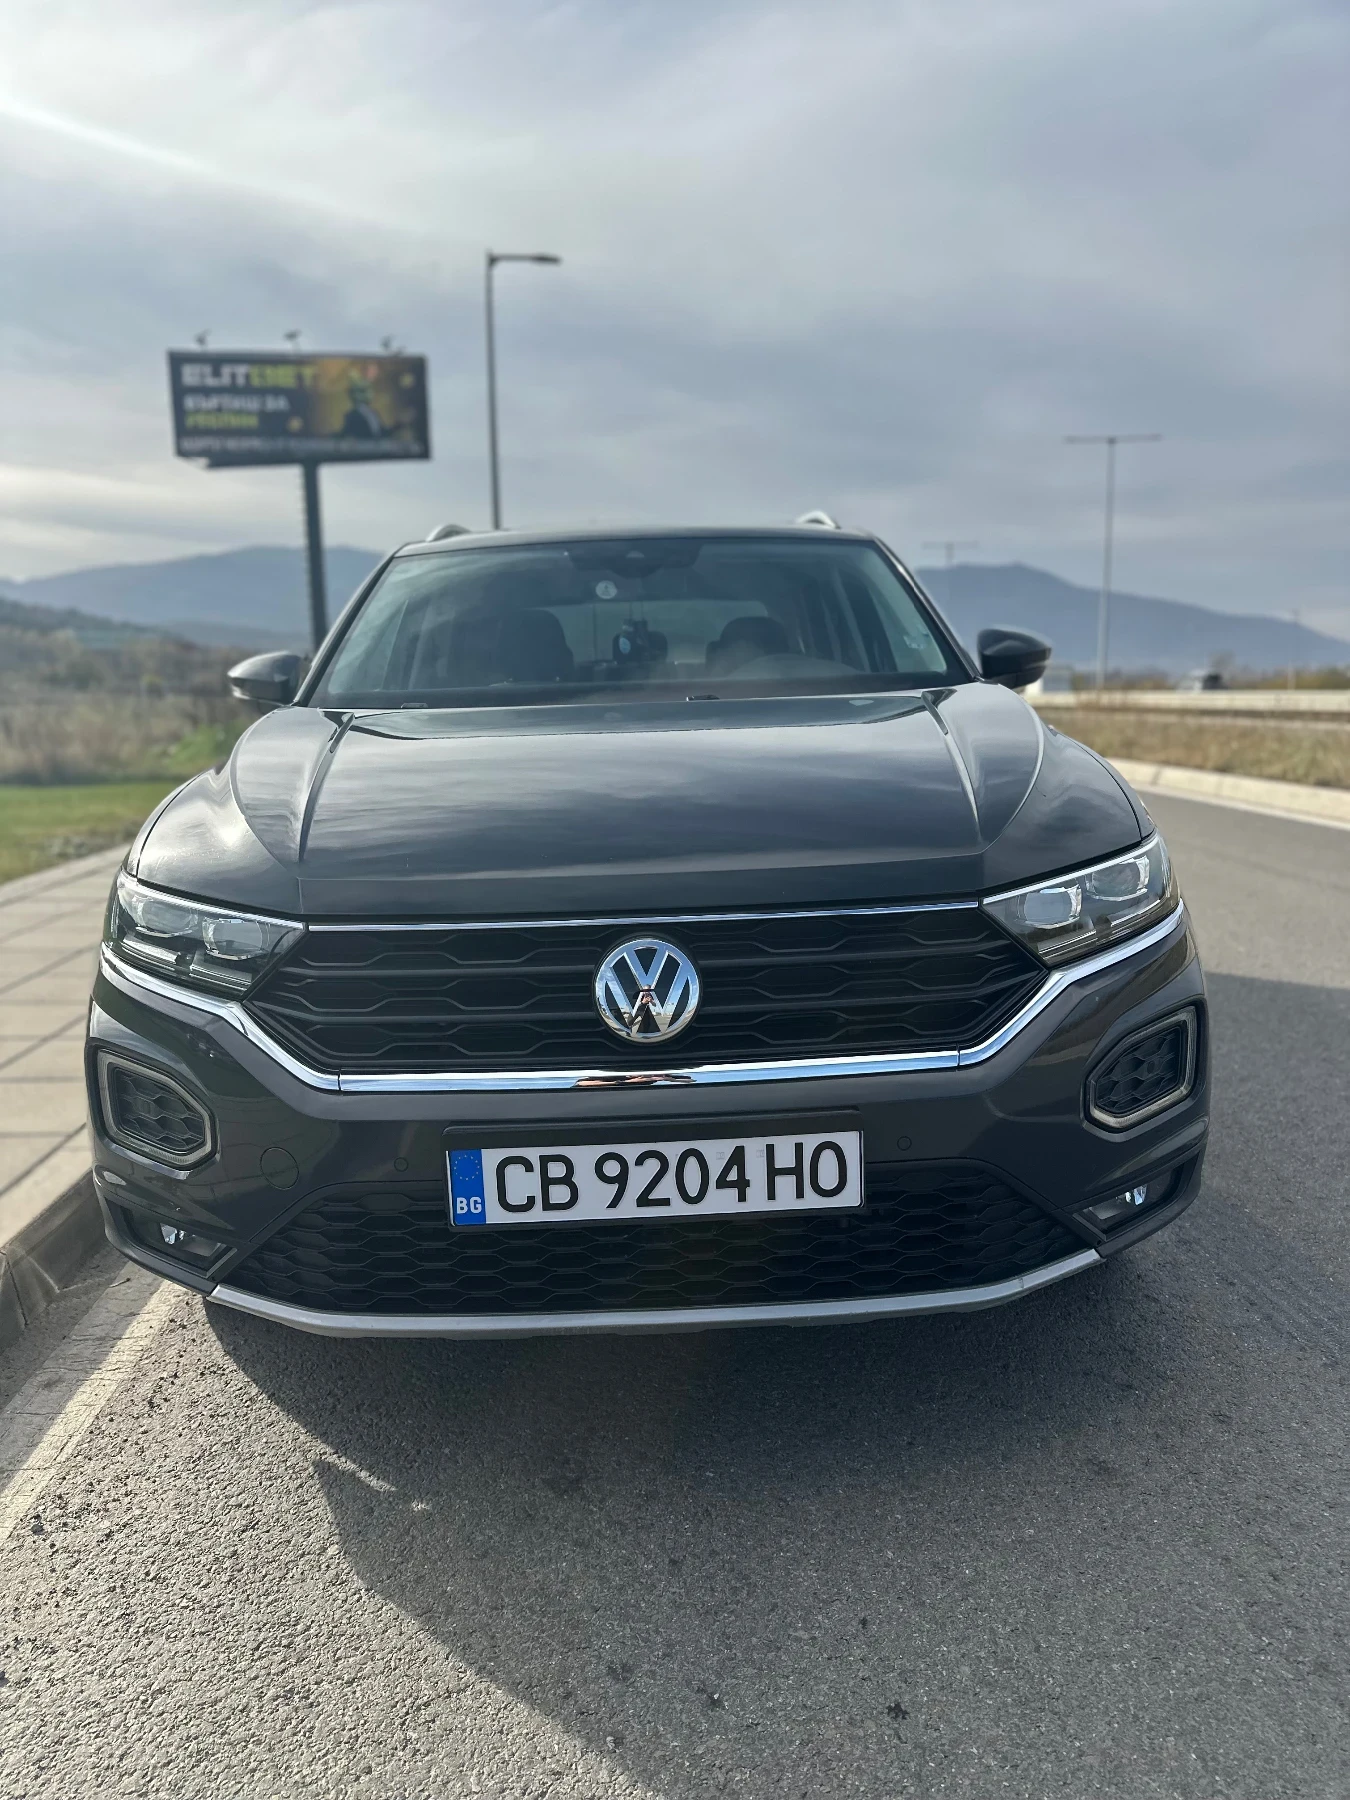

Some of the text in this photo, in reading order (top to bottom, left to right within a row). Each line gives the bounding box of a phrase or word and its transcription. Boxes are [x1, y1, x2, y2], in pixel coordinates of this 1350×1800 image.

[496, 1140, 849, 1213] CB 9204 HO
[456, 1197, 483, 1215] BG
